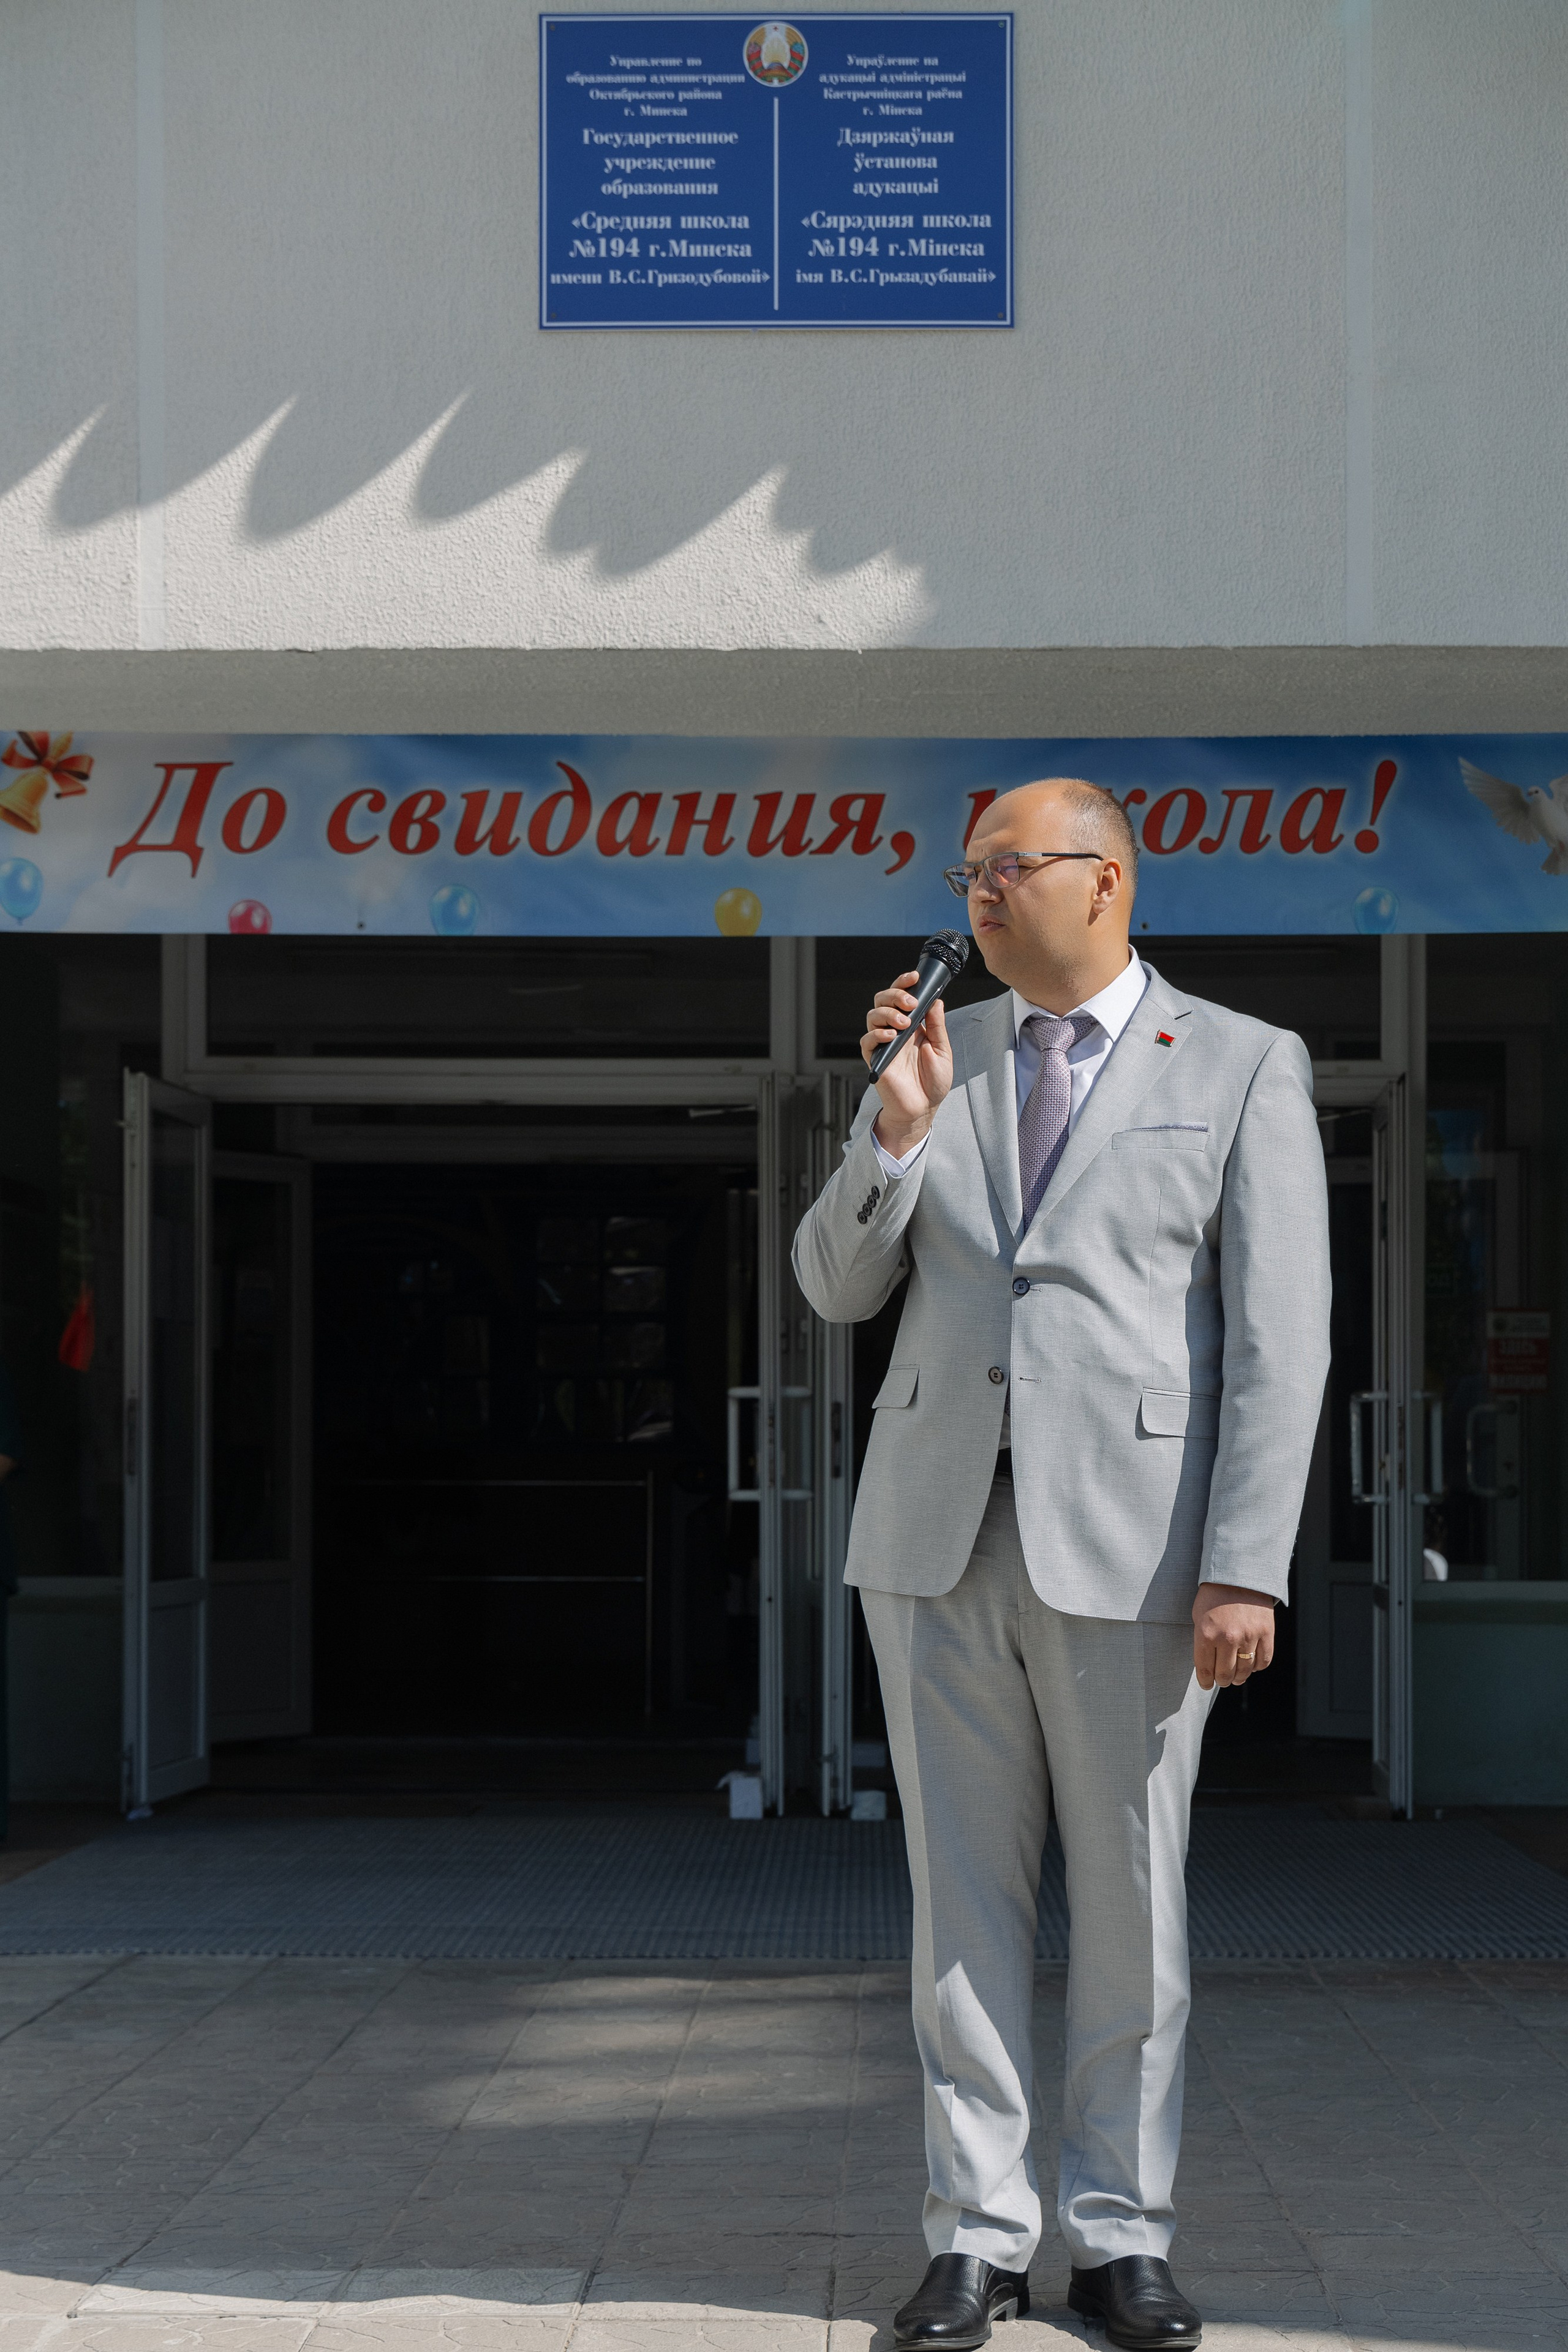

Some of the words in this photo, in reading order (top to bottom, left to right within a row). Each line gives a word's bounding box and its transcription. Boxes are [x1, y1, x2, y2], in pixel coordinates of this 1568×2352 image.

[687, 57, 703, 67] по
[589, 88, 675, 102] Октябрьского
[678, 88, 723, 102] района
[926, 87, 963, 102] раёна
[624, 107, 635, 116] г.
[639, 104, 688, 116] Минска
[862, 107, 874, 116] г.
[878, 104, 923, 116] Мінска
[582, 128, 739, 148] Государственное
[837, 127, 954, 148] Дзяржаўная
[604, 157, 716, 174] учреждение
[853, 153, 938, 173] ўстанова
[601, 178, 718, 199] образования
[853, 178, 939, 198] адукацыі
[571, 211, 672, 234] «Средняя
[680, 215, 750, 229] школа
[801, 210, 914, 233] «Сярэдняя
[922, 214, 992, 228] школа
[568, 237, 640, 258] №194
[649, 239, 752, 258] г.Минска
[808, 236, 880, 257] №194
[888, 238, 985, 257] г.Мінска
[550, 273, 602, 284] имени
[609, 268, 771, 287] В.С.Гризодубовой»
[796, 269, 824, 284] імя
[831, 268, 997, 287] В.С.Грызадубавай»
[108, 763, 286, 878] До
[327, 761, 915, 875] свидания,
[963, 760, 1398, 855] ола!
